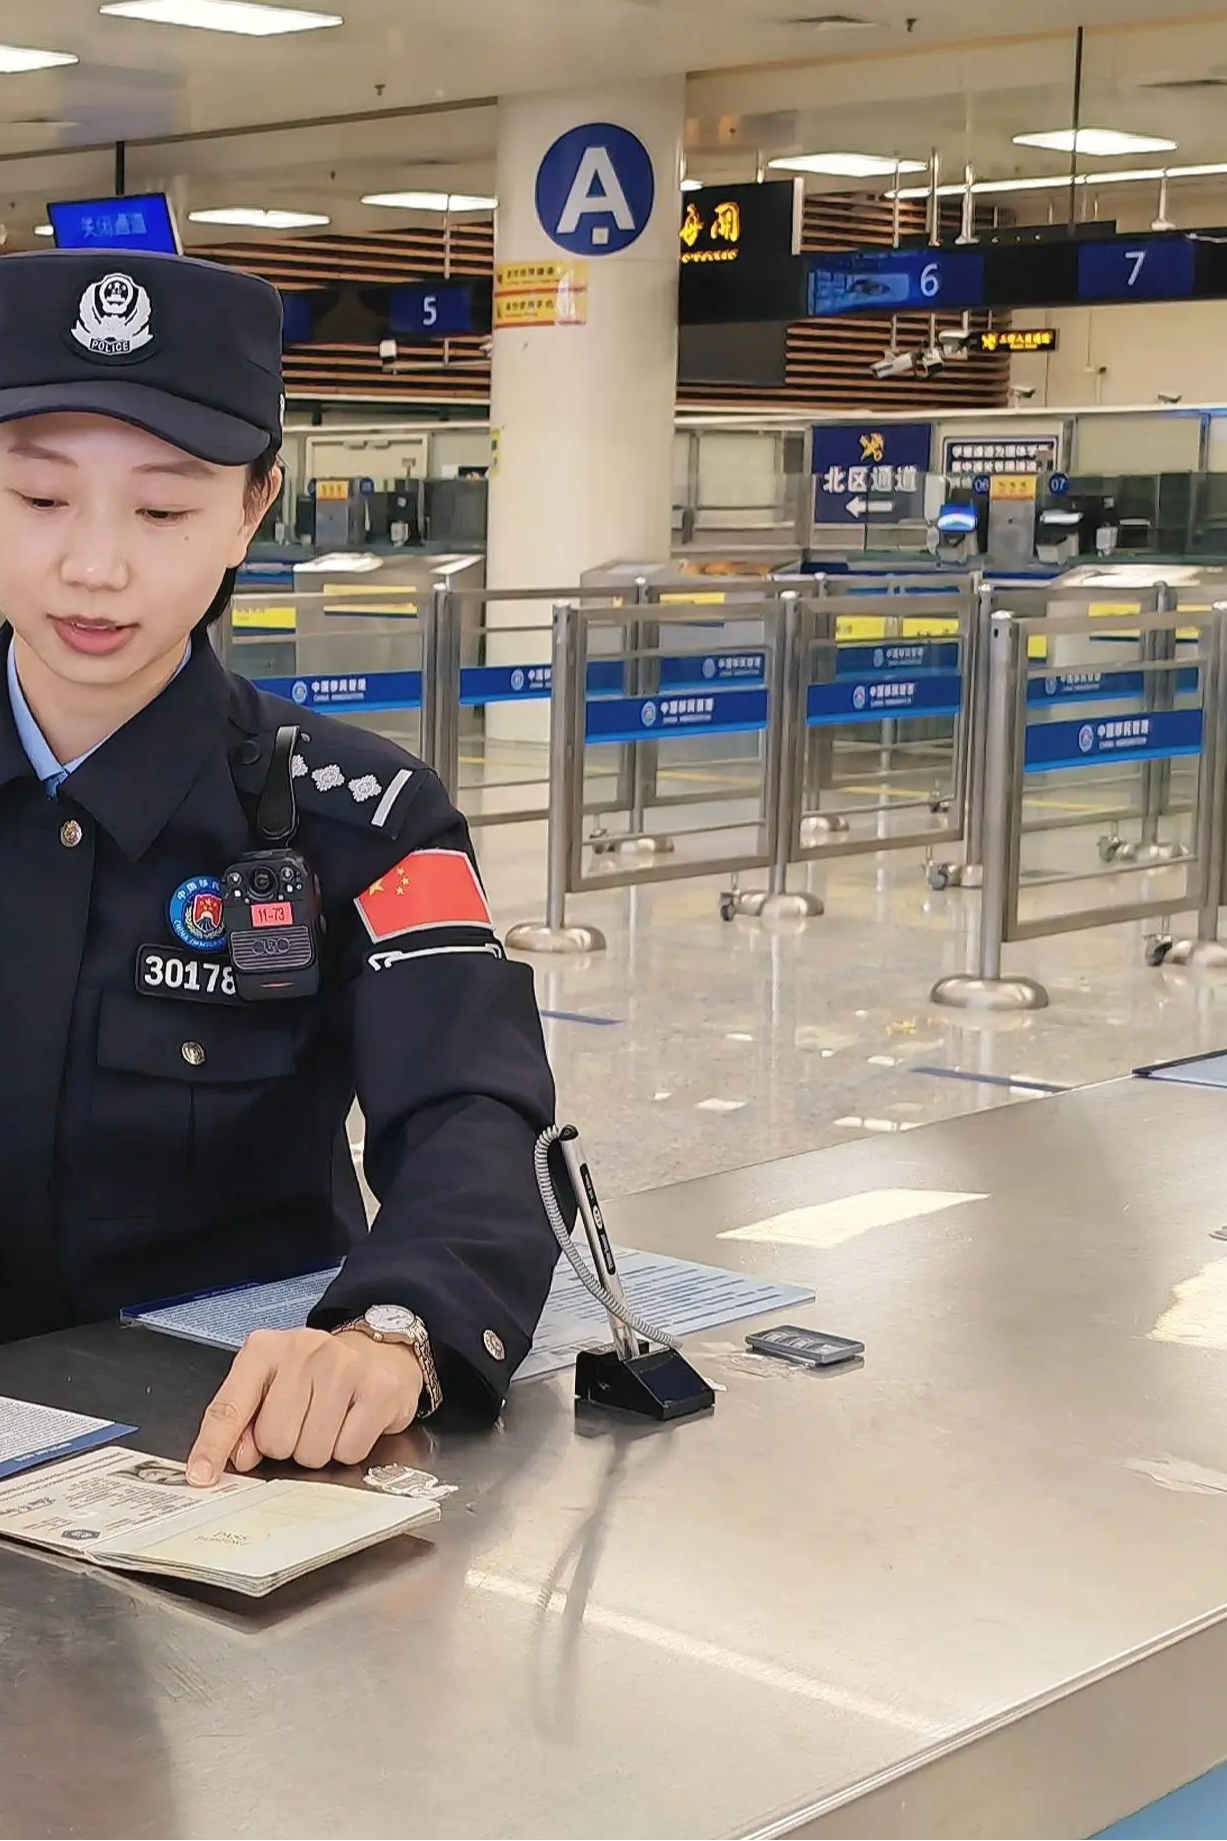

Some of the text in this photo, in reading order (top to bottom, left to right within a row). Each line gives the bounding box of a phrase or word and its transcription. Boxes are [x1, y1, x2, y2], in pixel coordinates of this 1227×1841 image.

[557, 147, 636, 233] A
[920, 263, 940, 297] 6
[1125, 251, 1147, 286] 7
[423, 295, 437, 326] 5
[91, 340, 129, 353] POLICE
[823, 464, 918, 494] 北区通道
[1051, 479, 1066, 492] 07
[257, 906, 285, 923] 11-73
